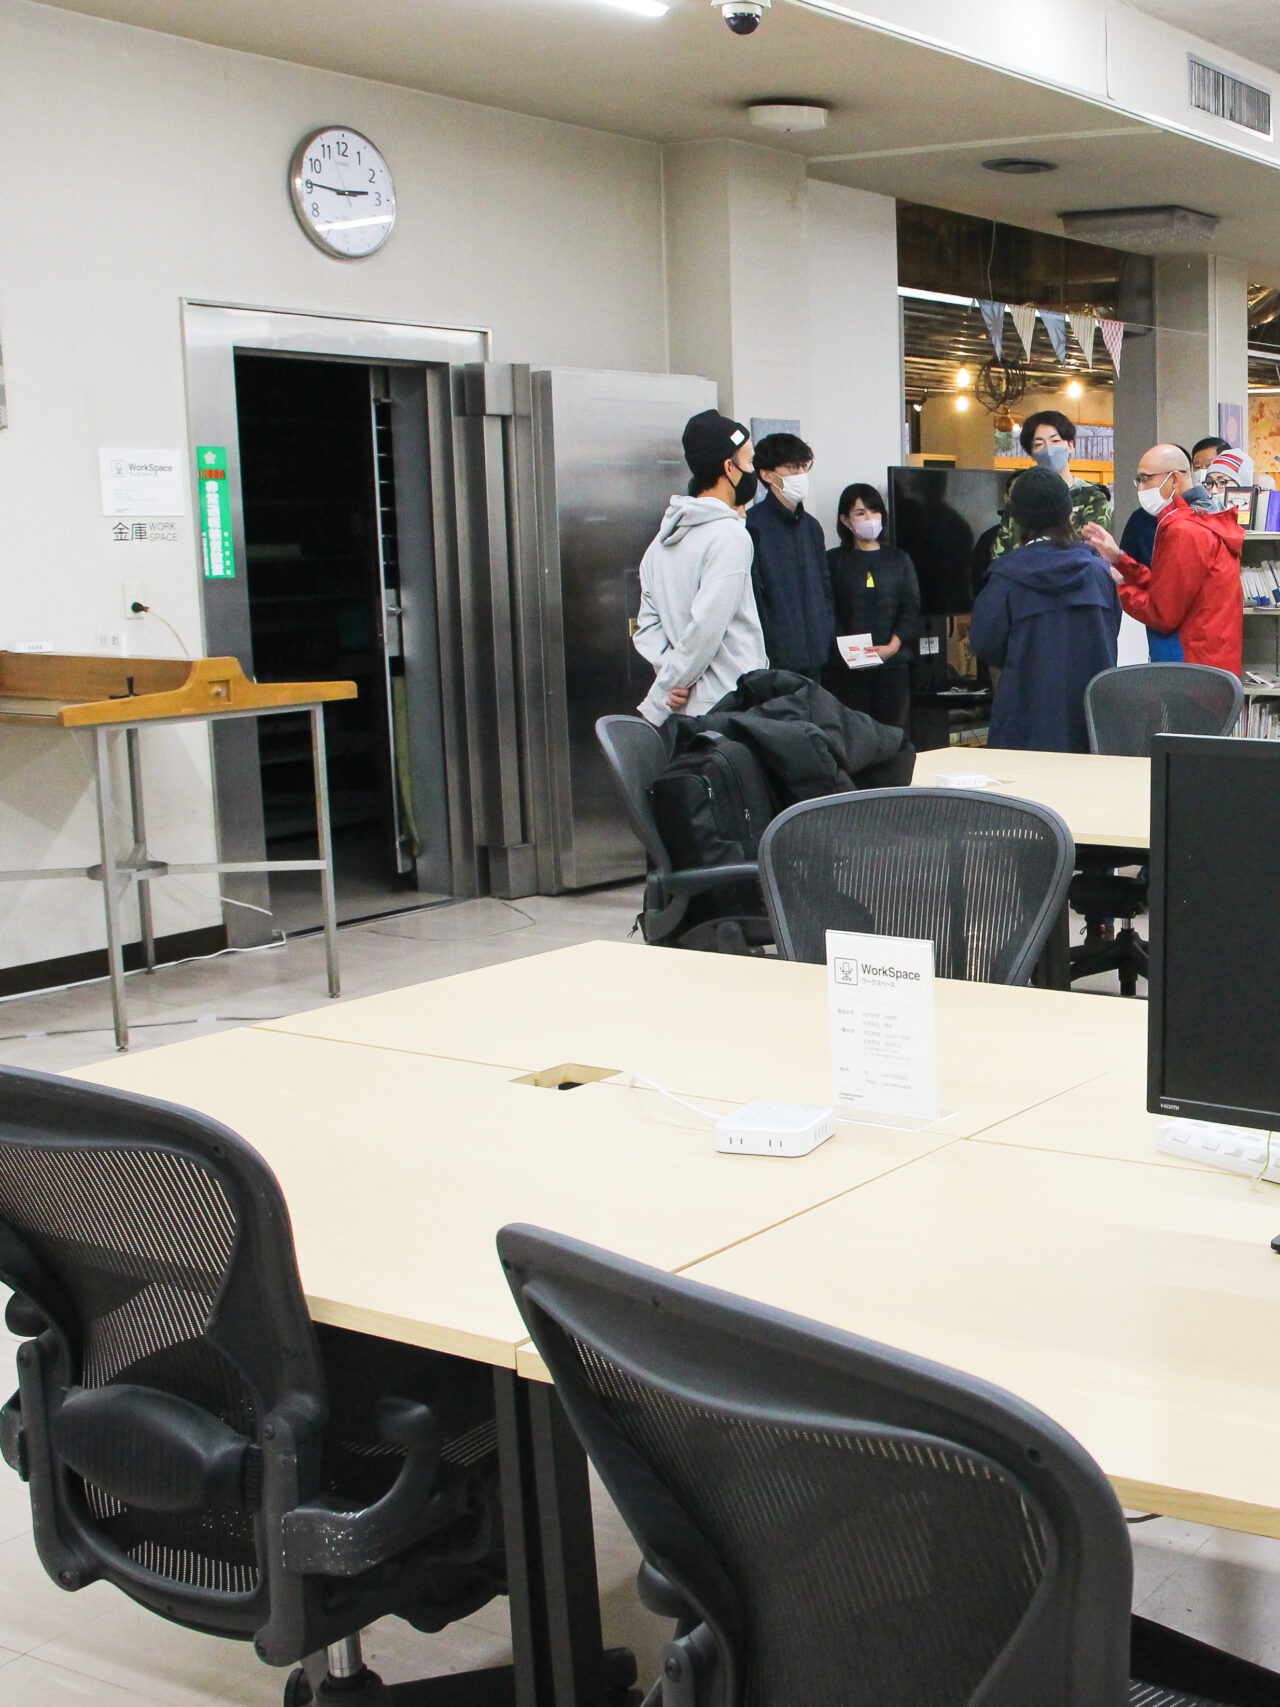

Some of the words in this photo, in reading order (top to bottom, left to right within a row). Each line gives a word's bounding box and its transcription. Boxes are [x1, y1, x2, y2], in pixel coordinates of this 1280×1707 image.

[321, 143, 331, 159] 11
[336, 141, 348, 157] 12
[309, 157, 322, 173] 10
[356, 151, 361, 165] 1
[368, 168, 376, 183] 2
[305, 179, 313, 194] 9
[374, 192, 381, 206] 3
[311, 202, 319, 217] 8
[128, 463, 173, 473] WorkSpace
[112, 522, 149, 542] 金庫
[148, 522, 177, 531] WORK
[149, 533, 178, 542] SPACE
[861, 963, 921, 981] WorkSpace
